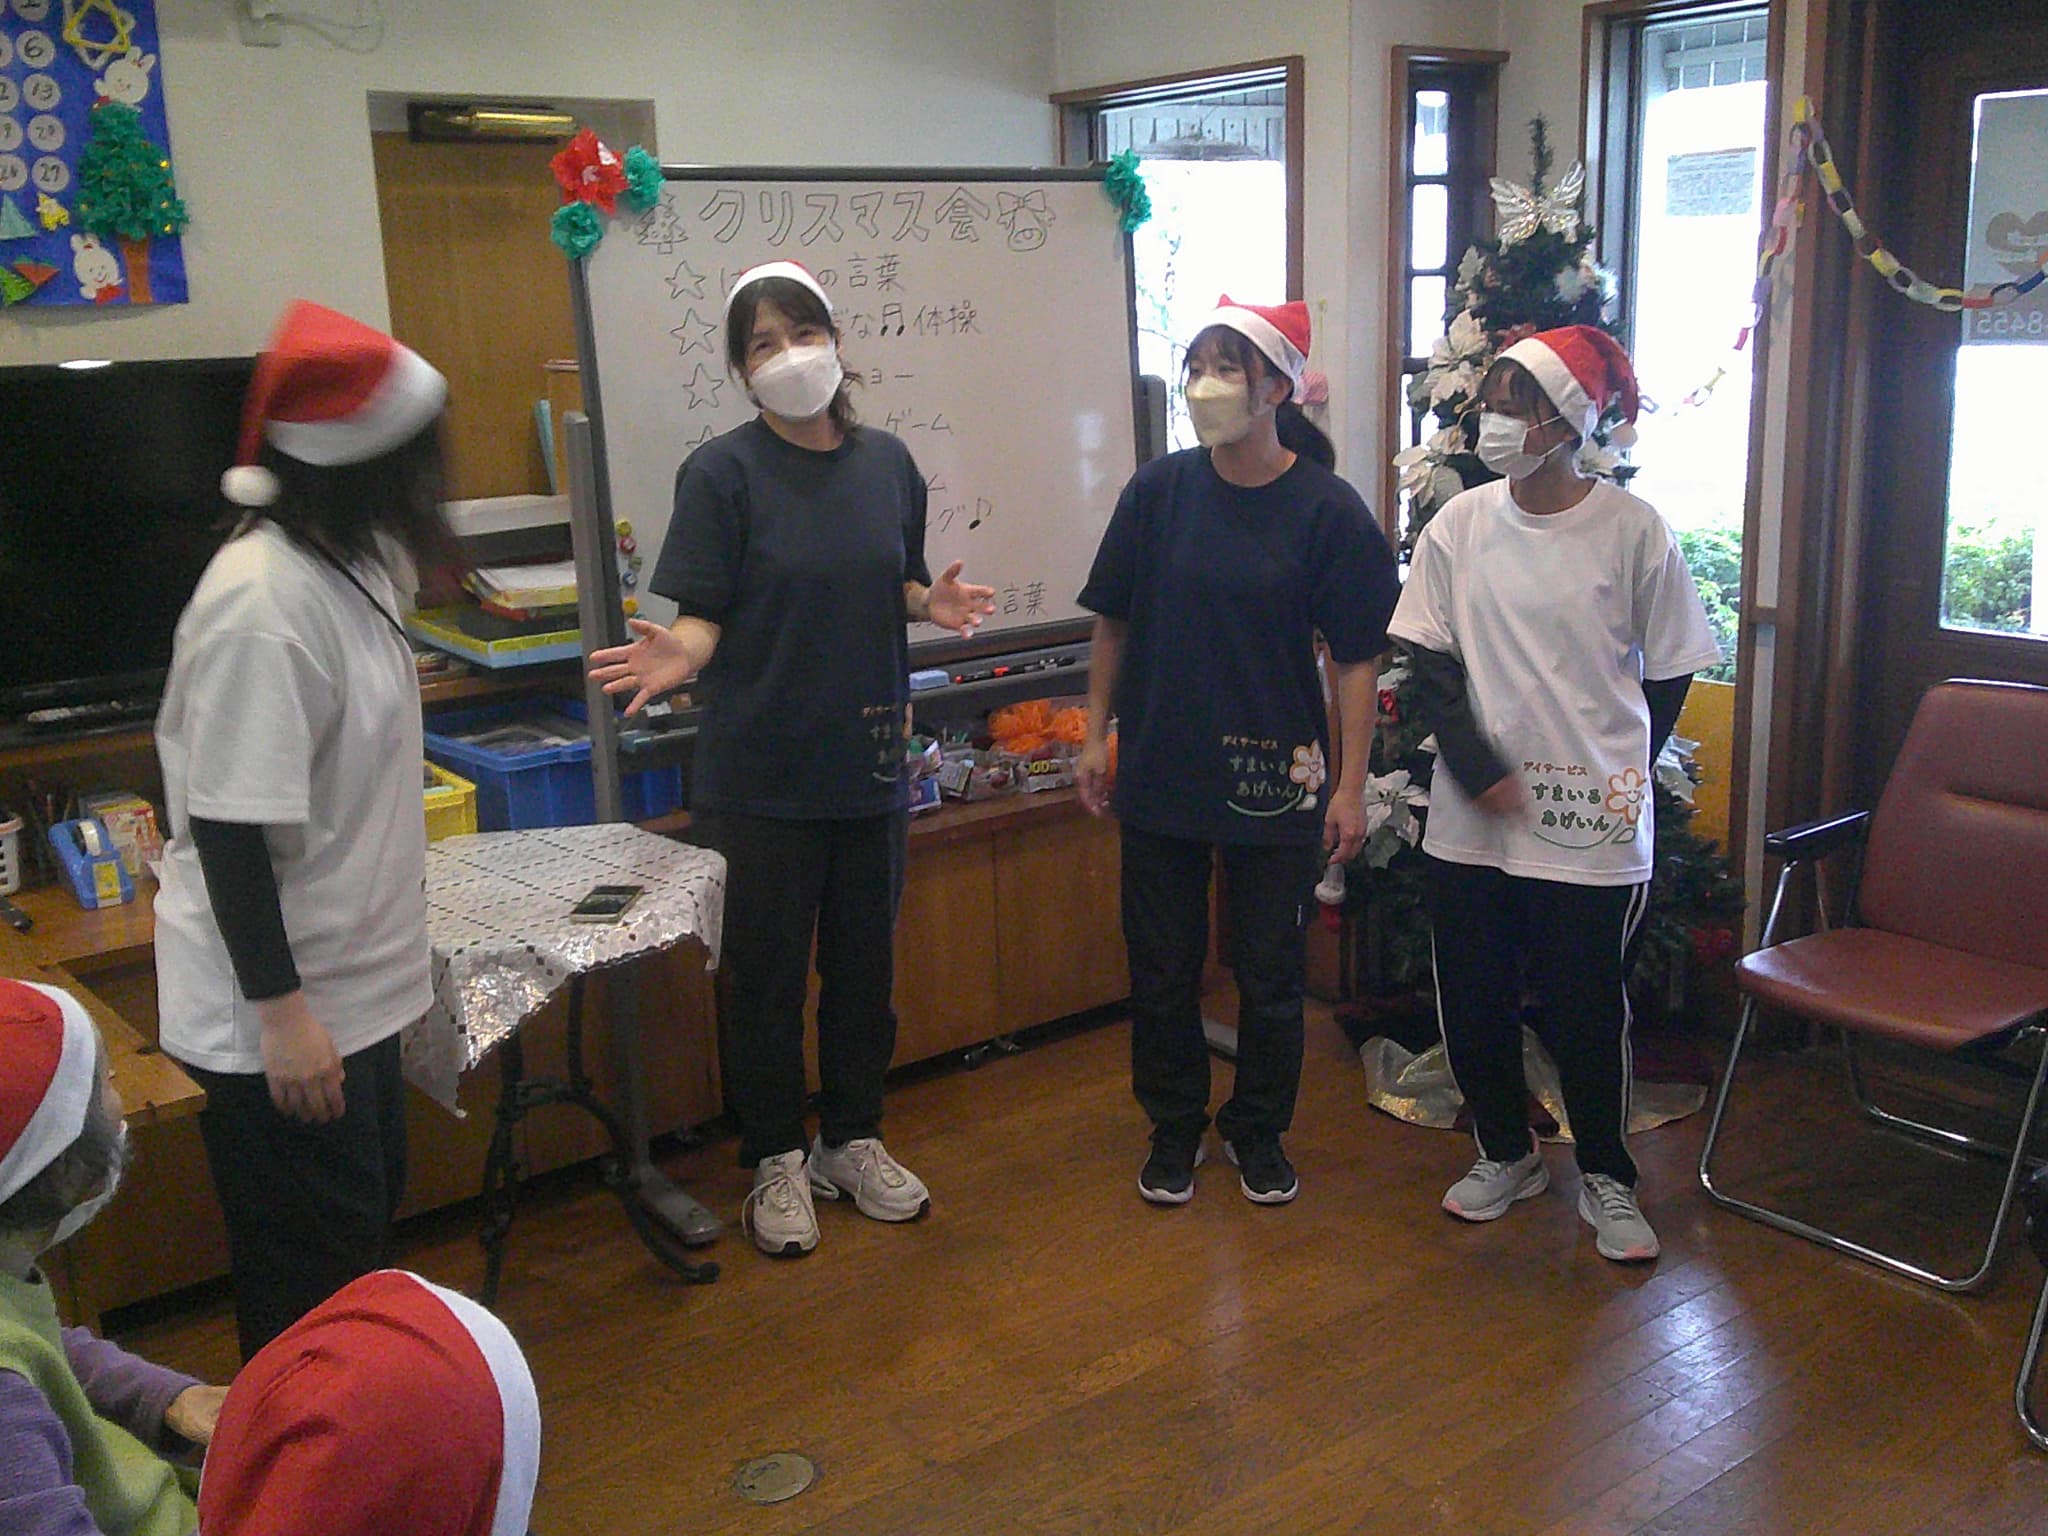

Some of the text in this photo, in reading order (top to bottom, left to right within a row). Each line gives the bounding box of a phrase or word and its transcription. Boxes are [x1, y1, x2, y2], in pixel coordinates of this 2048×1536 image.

[23, 36, 43, 58] 6
[32, 80, 53, 101] 13
[39, 162, 61, 182] 27
[699, 186, 990, 247] クリスマス会
[1532, 782, 1602, 805] すまいる
[1541, 809, 1610, 832] あげいん
